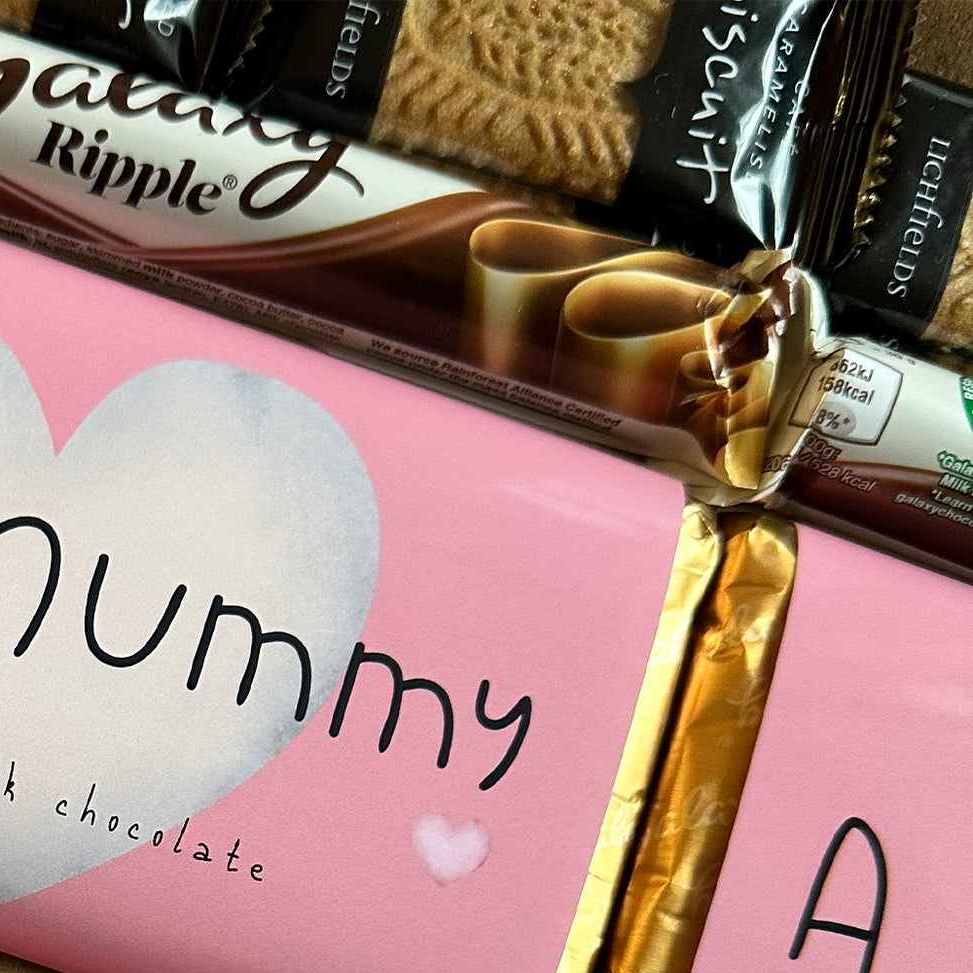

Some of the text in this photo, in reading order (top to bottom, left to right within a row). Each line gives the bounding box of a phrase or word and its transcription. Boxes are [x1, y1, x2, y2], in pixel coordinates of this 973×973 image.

[676, 0, 760, 205] iscuit
[142, 263, 174, 279] milk
[56, 784, 263, 881] chocolate
